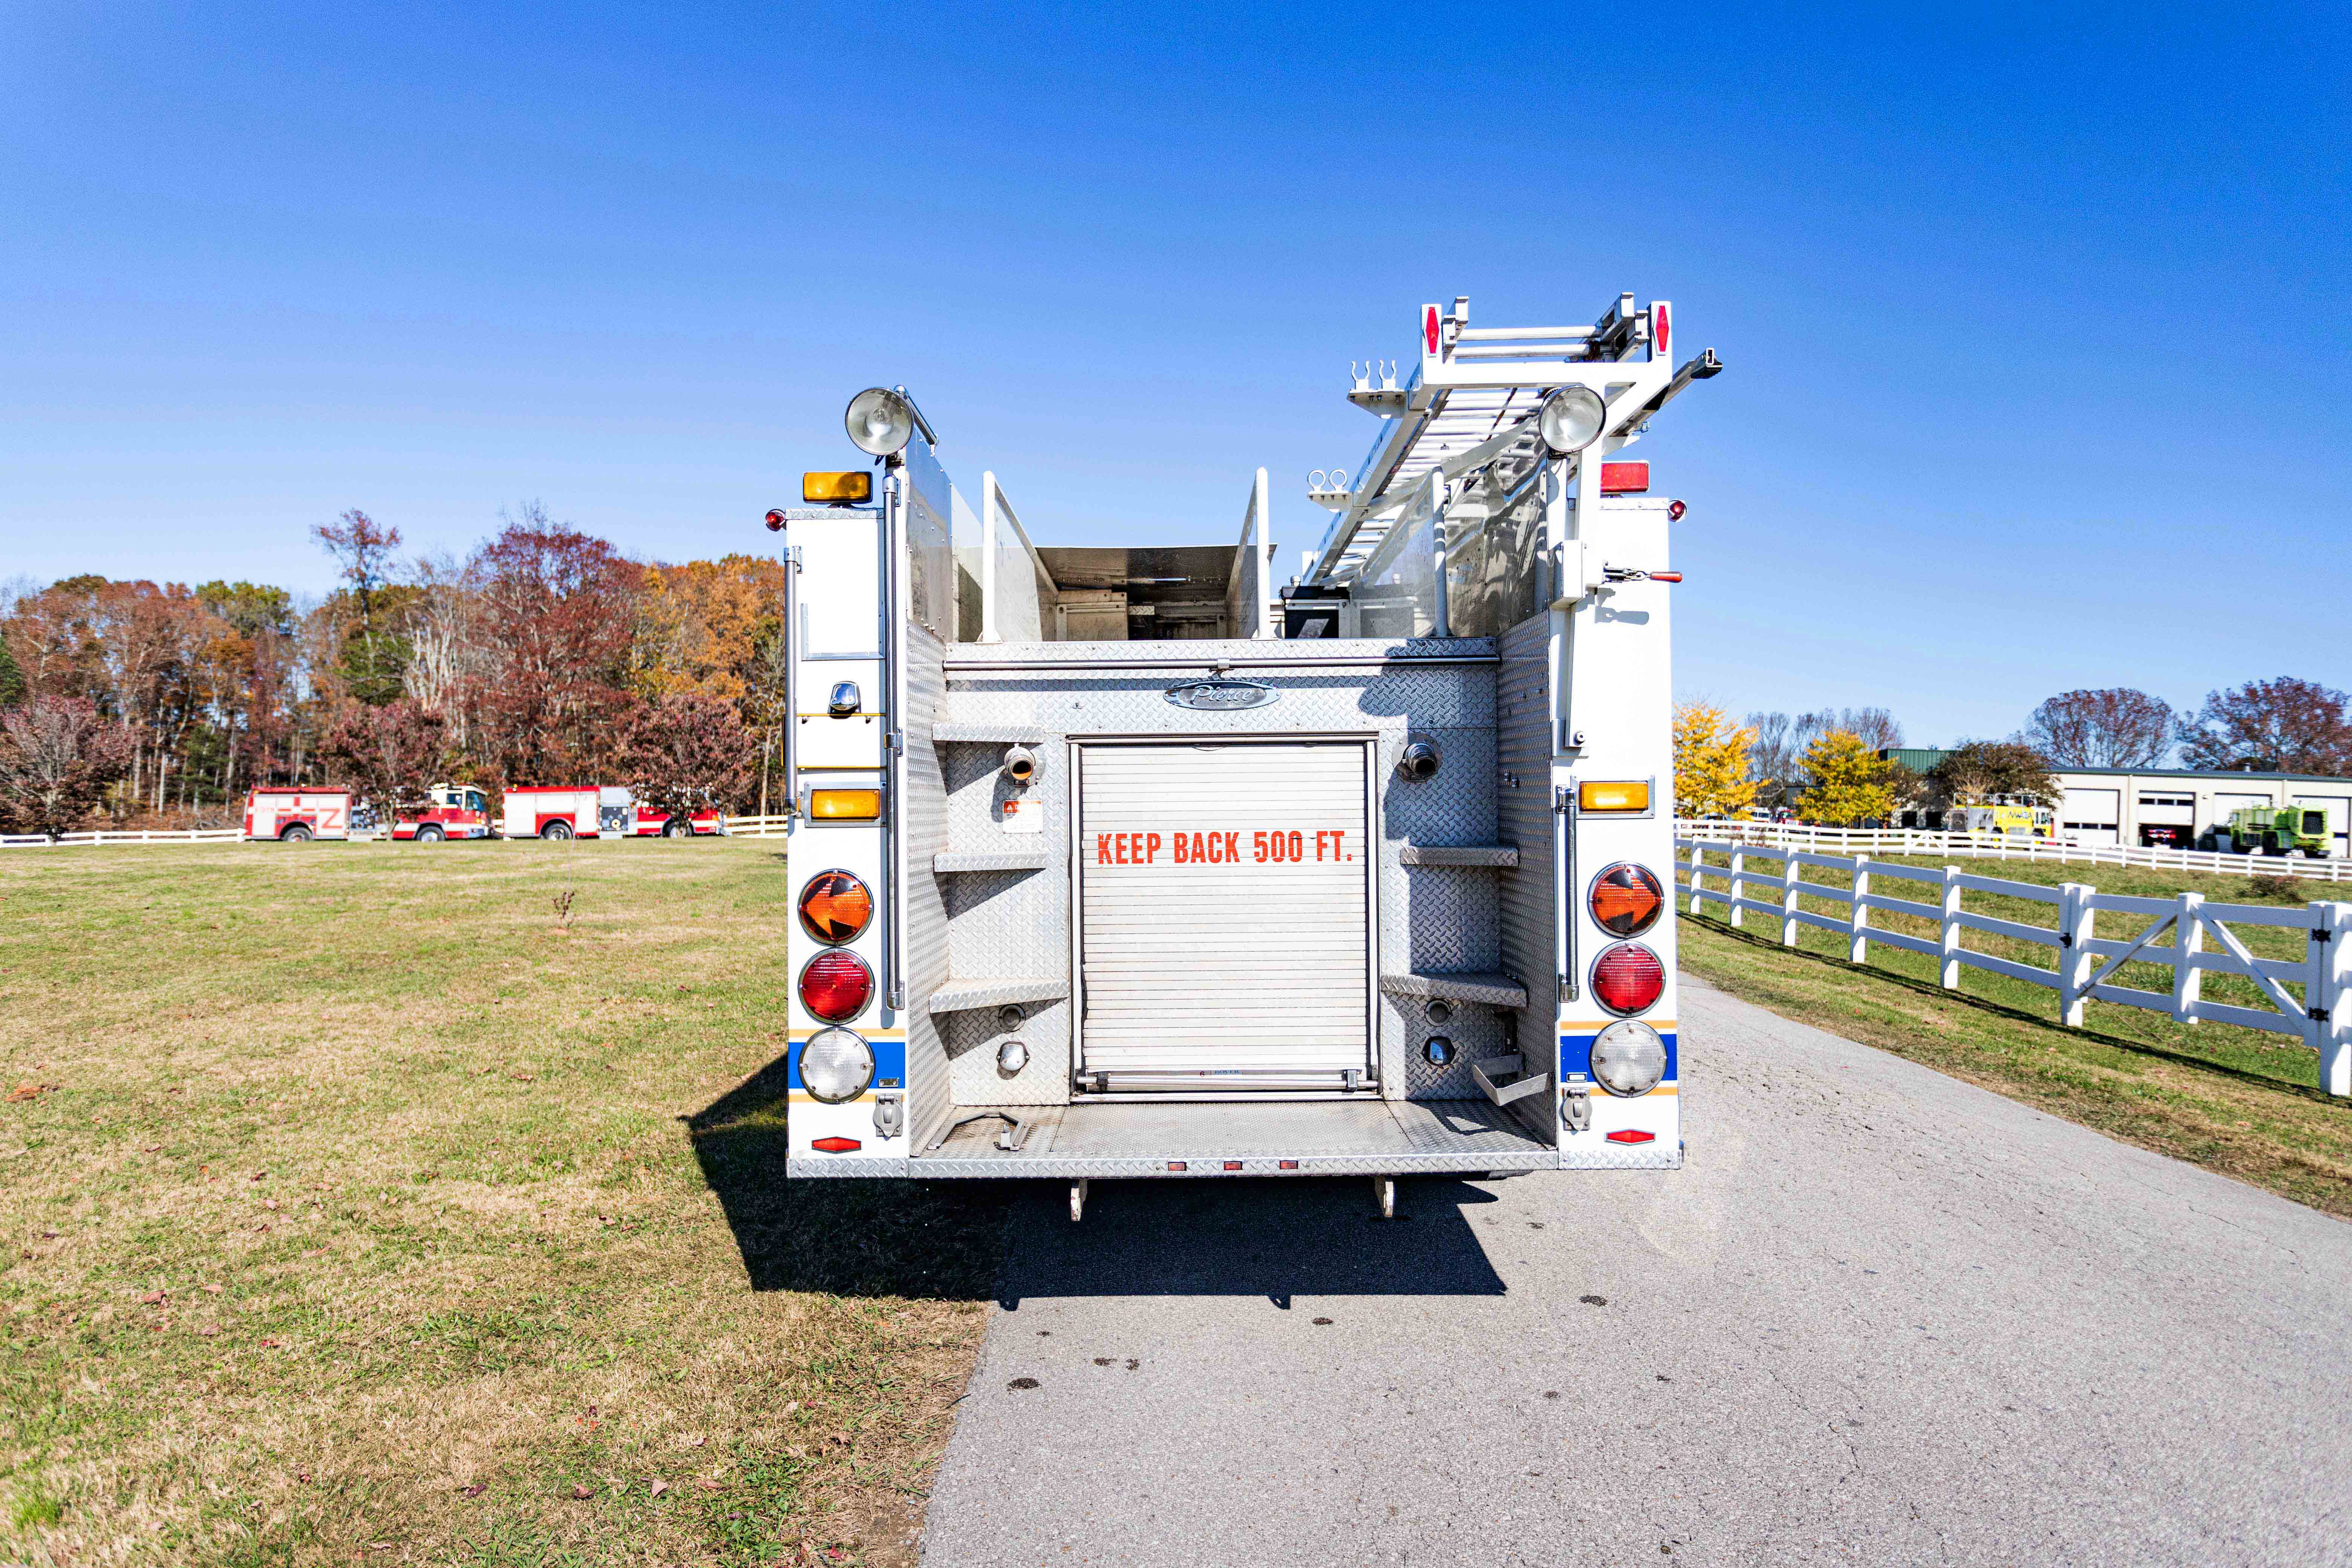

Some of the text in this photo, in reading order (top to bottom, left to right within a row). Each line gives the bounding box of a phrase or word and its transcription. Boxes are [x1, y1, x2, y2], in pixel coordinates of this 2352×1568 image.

[1190, 685, 1254, 705] Pierce
[1098, 831, 1352, 864] KEEP BACK 500 FT.
